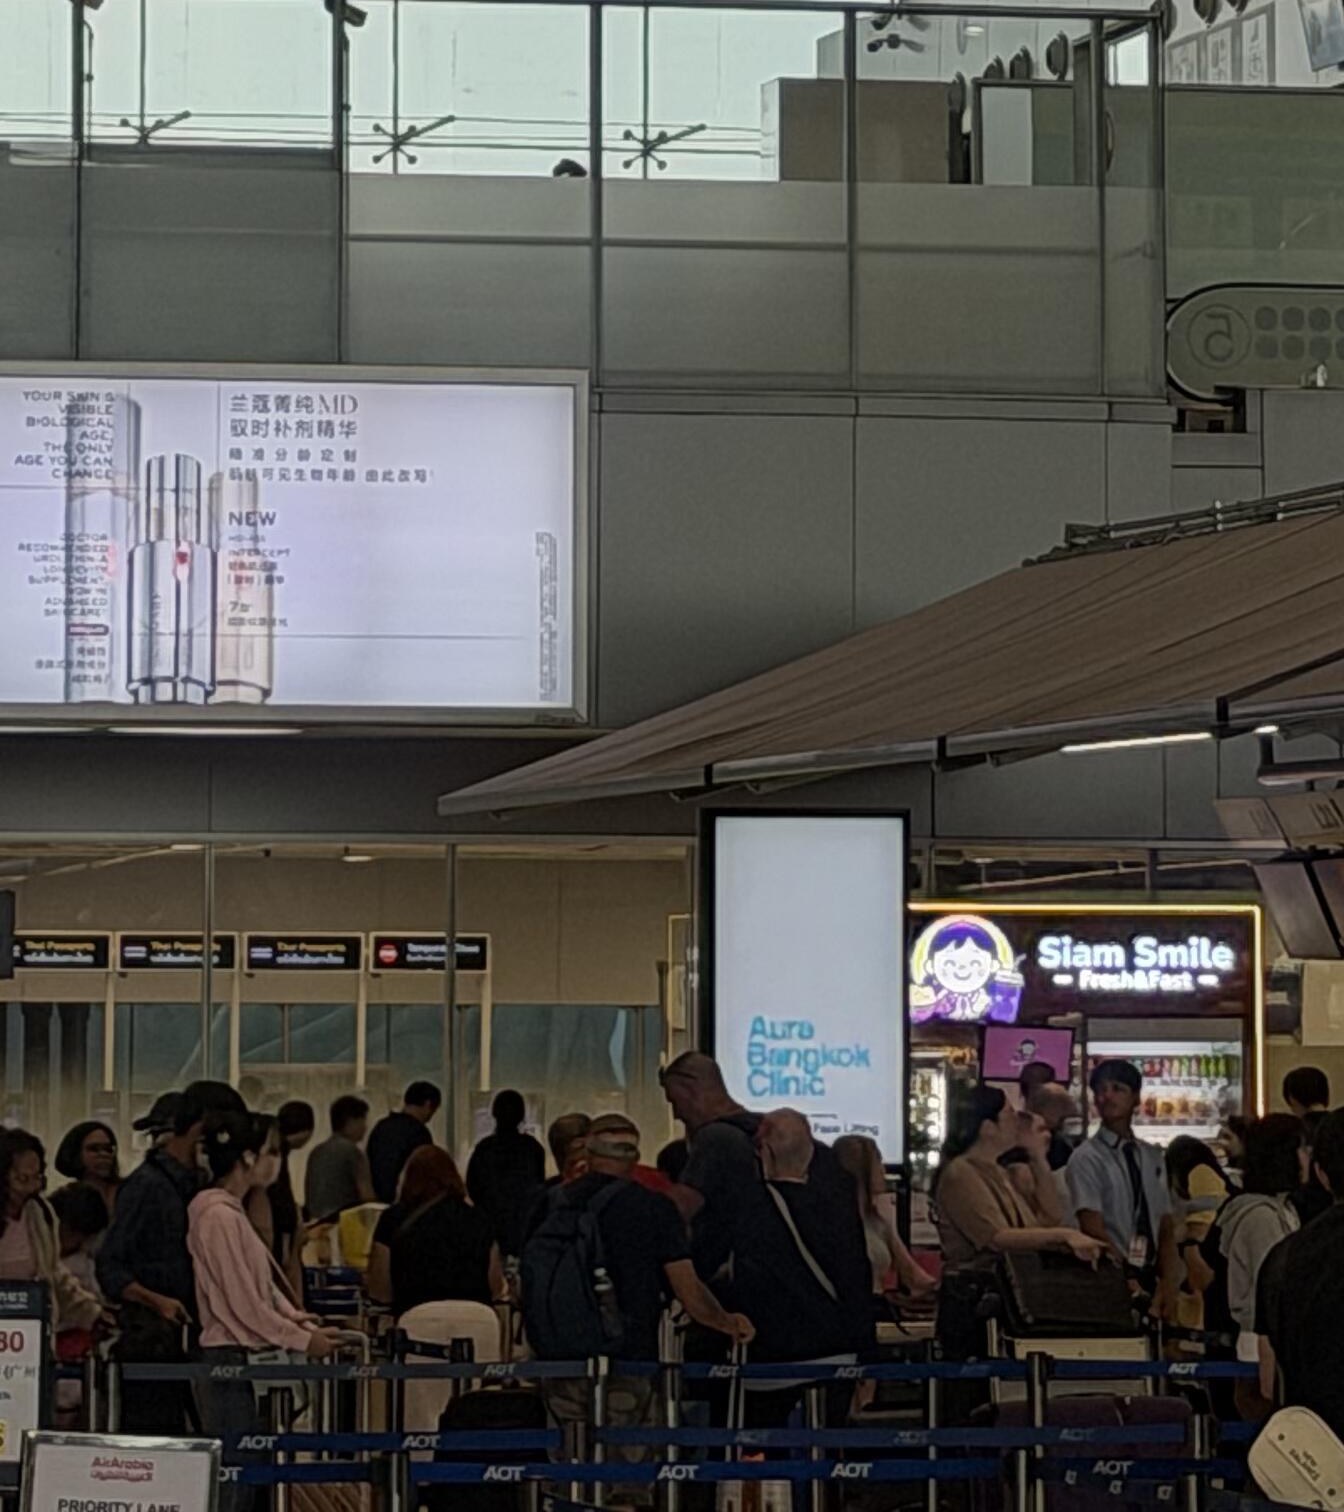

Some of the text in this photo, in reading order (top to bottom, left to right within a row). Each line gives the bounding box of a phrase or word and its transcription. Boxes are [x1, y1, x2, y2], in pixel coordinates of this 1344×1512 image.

[22, 390, 63, 402] YOUR
[76, 443, 113, 455] ONLY
[14, 454, 44, 465] AGE
[82, 455, 113, 466] CAN
[228, 511, 277, 527] NEW
[1037, 935, 1235, 971] Siam Smile
[749, 1015, 815, 1040] Aura
[747, 1042, 871, 1075] Bangkok
[747, 1068, 826, 1097] Clinic
[211, 1365, 244, 1378] AOT
[484, 1362, 516, 1376] AOT
[1167, 1363, 1200, 1376] AOT
[237, 1435, 280, 1450] AOT
[402, 1434, 440, 1449] AOT
[218, 1467, 244, 1482] OT
[483, 1465, 525, 1481] AOT
[657, 1464, 699, 1480] AOT
[830, 1462, 872, 1479] AOT
[1092, 1460, 1134, 1476] AOT
[57, 1498, 135, 1512] PRIORITY
